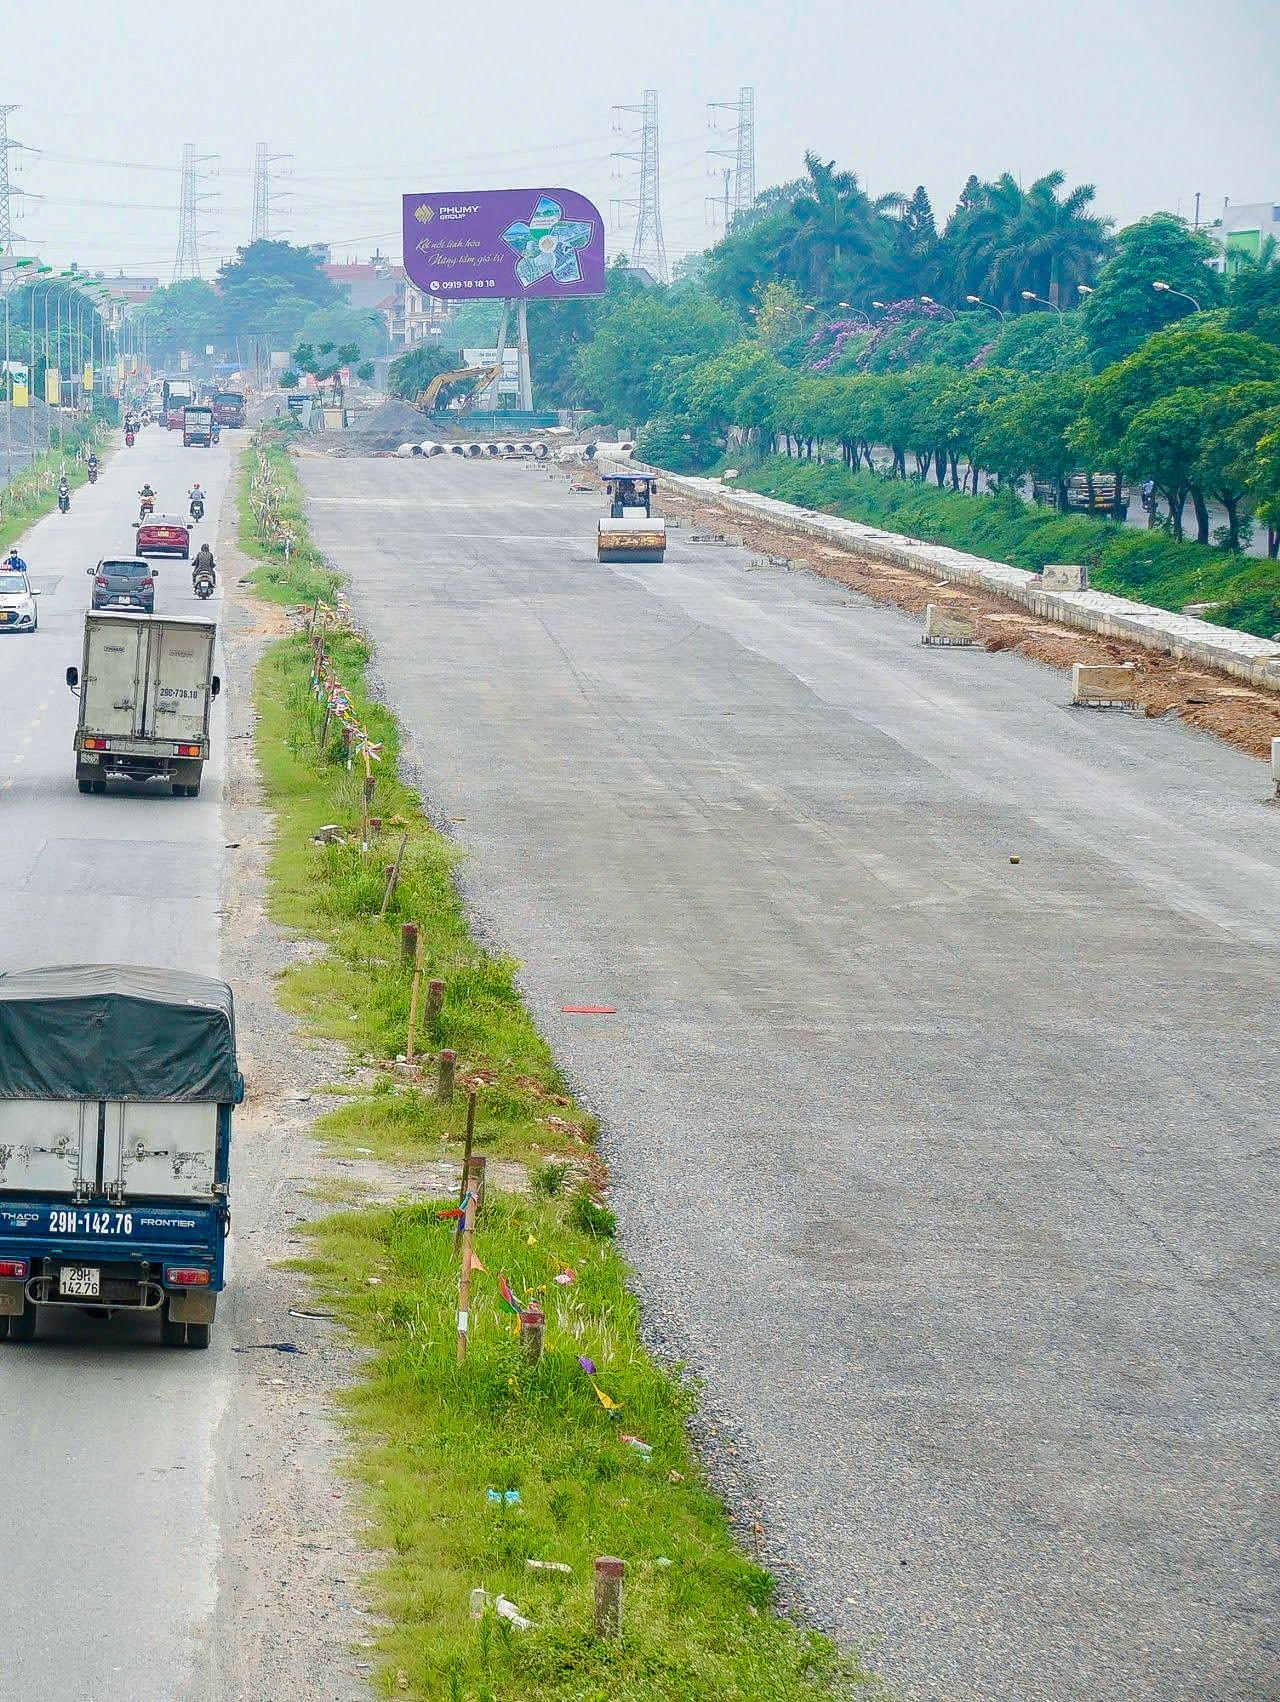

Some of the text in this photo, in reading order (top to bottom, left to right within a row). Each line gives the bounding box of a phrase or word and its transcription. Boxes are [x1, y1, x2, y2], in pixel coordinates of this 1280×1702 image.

[439, 206, 479, 214] PHUMY
[442, 279, 495, 289] 0919 18 18 18
[1, 1212, 40, 1221] THACO
[49, 1211, 133, 1235] 29H-142.76
[140, 1218, 196, 1228] FRONTIER
[70, 1268, 91, 1281] 29H
[62, 1281, 98, 1295] 142.76
